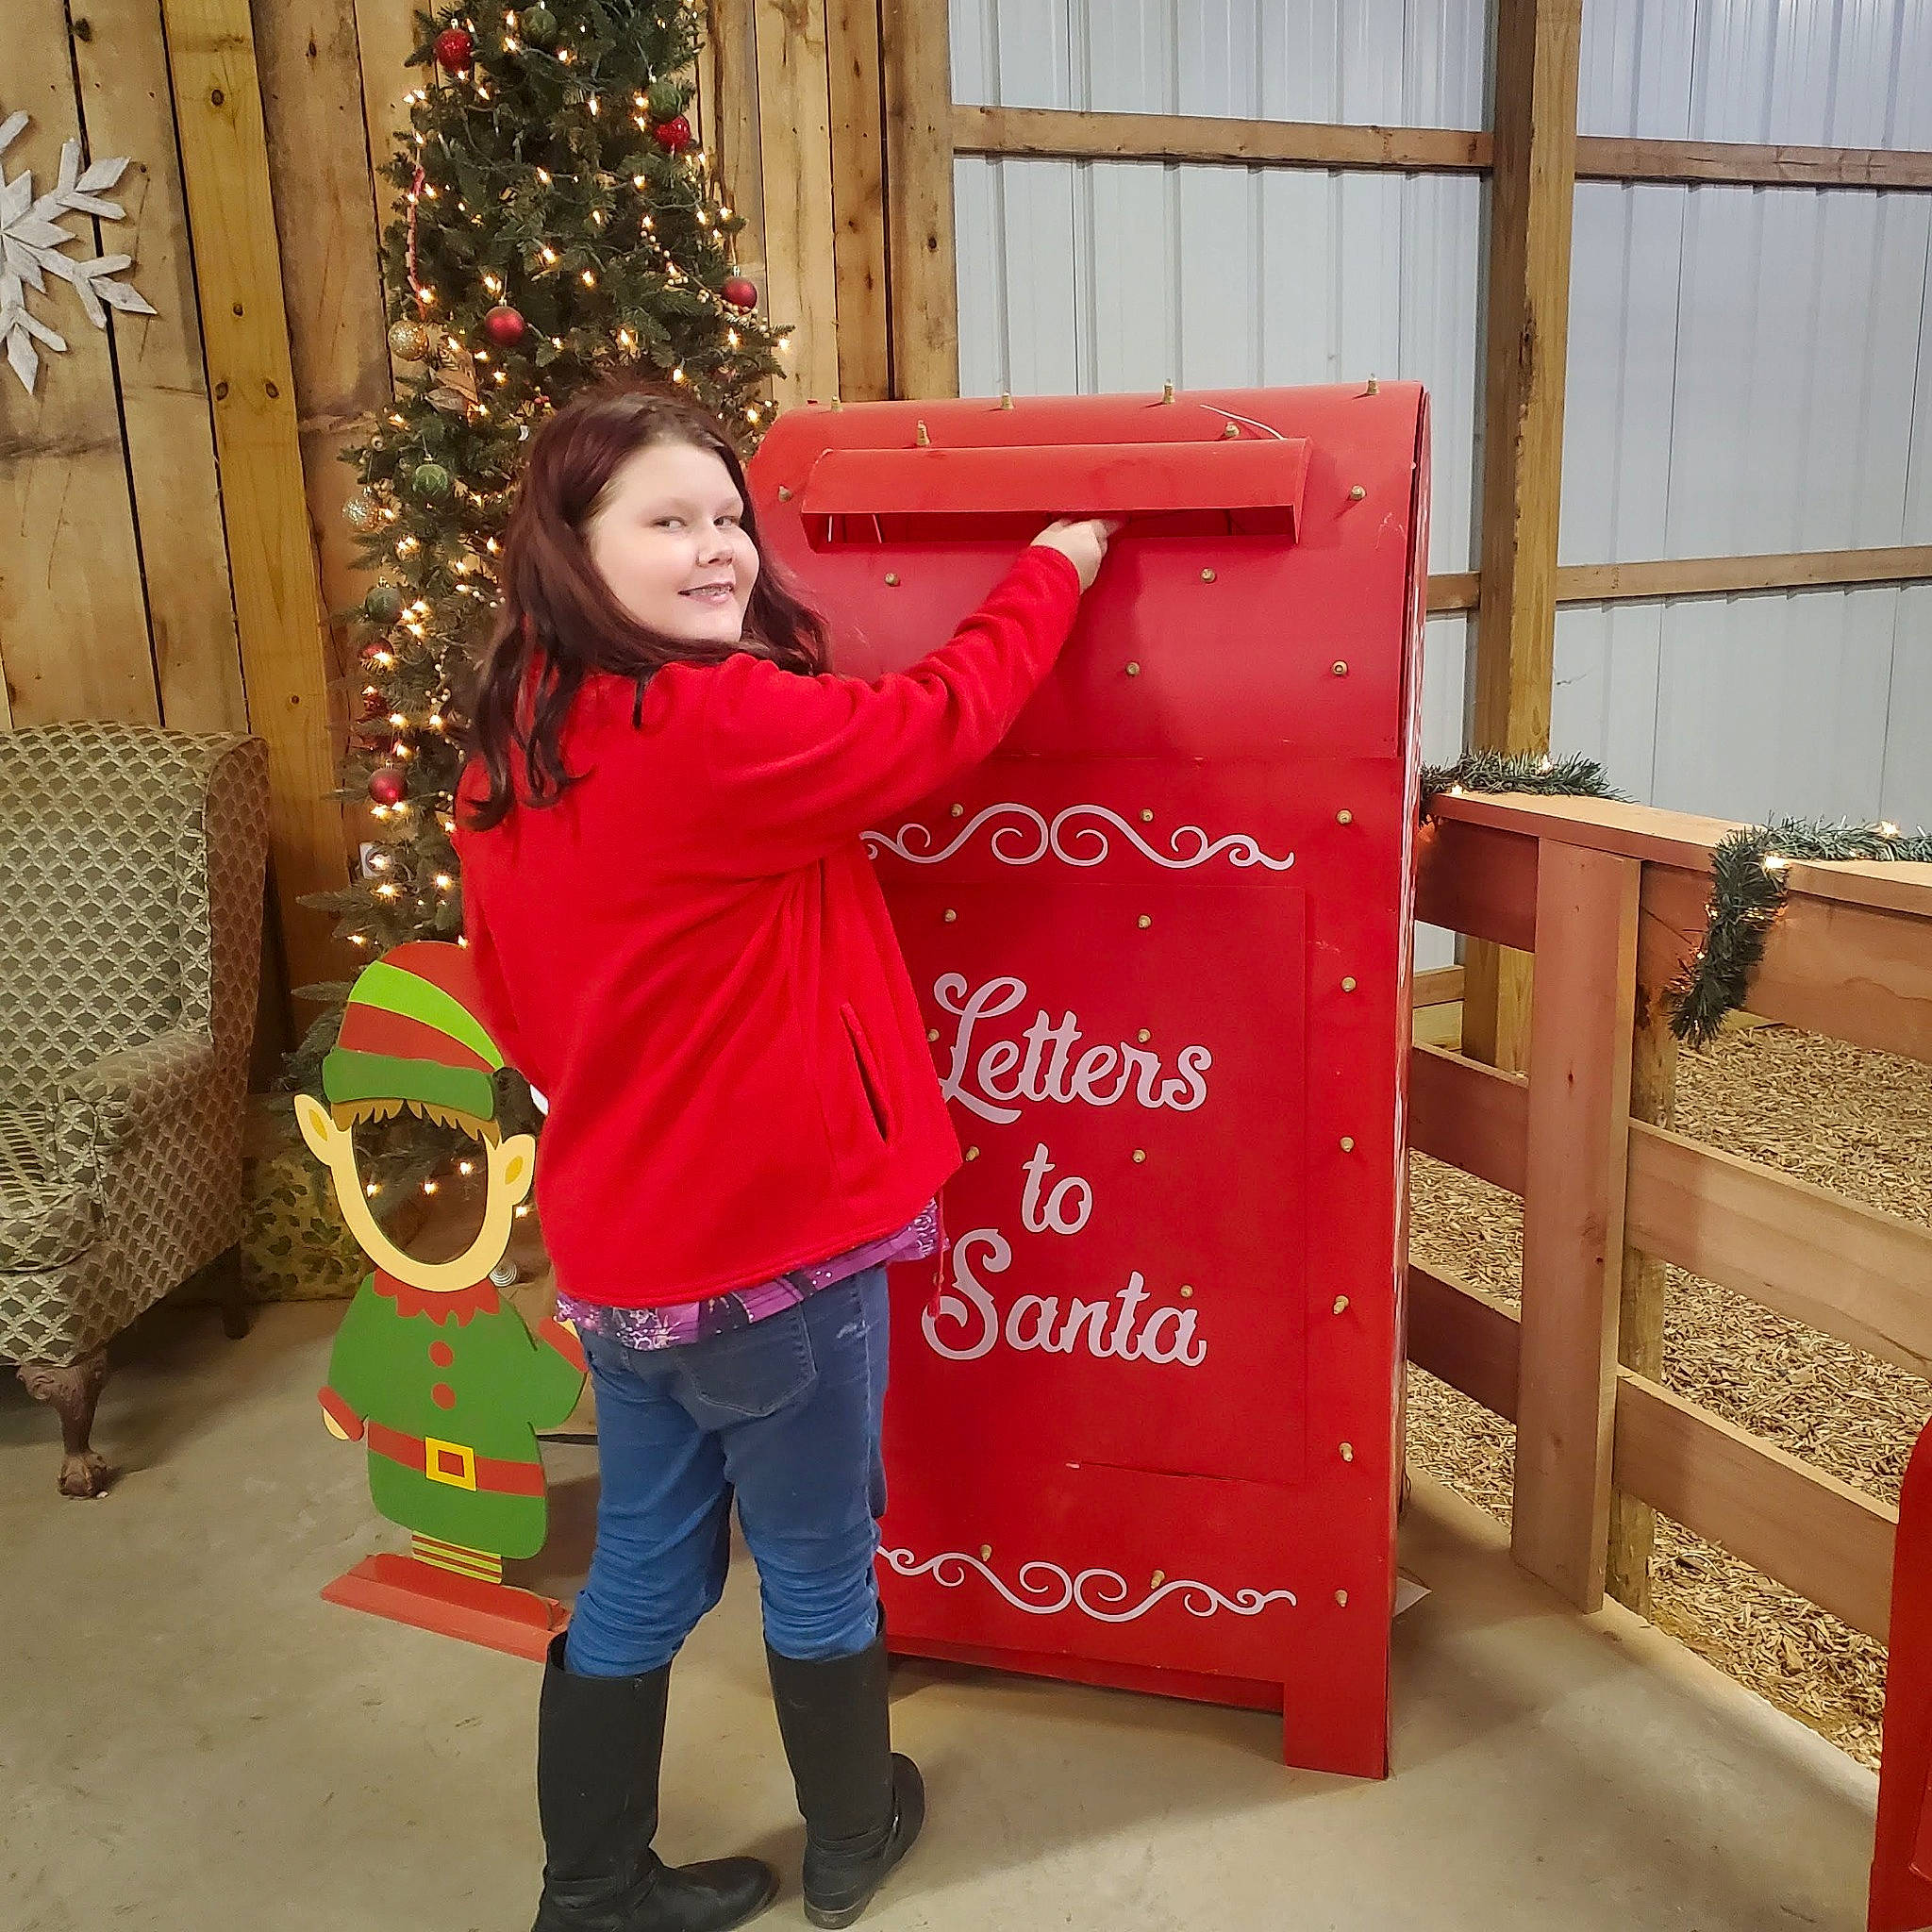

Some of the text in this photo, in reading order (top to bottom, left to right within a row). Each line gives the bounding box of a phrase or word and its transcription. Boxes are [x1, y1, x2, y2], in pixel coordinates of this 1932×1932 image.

[933, 973, 1212, 1124] Letters
[1022, 1142, 1092, 1235] to
[921, 1228, 1208, 1367] Santa
